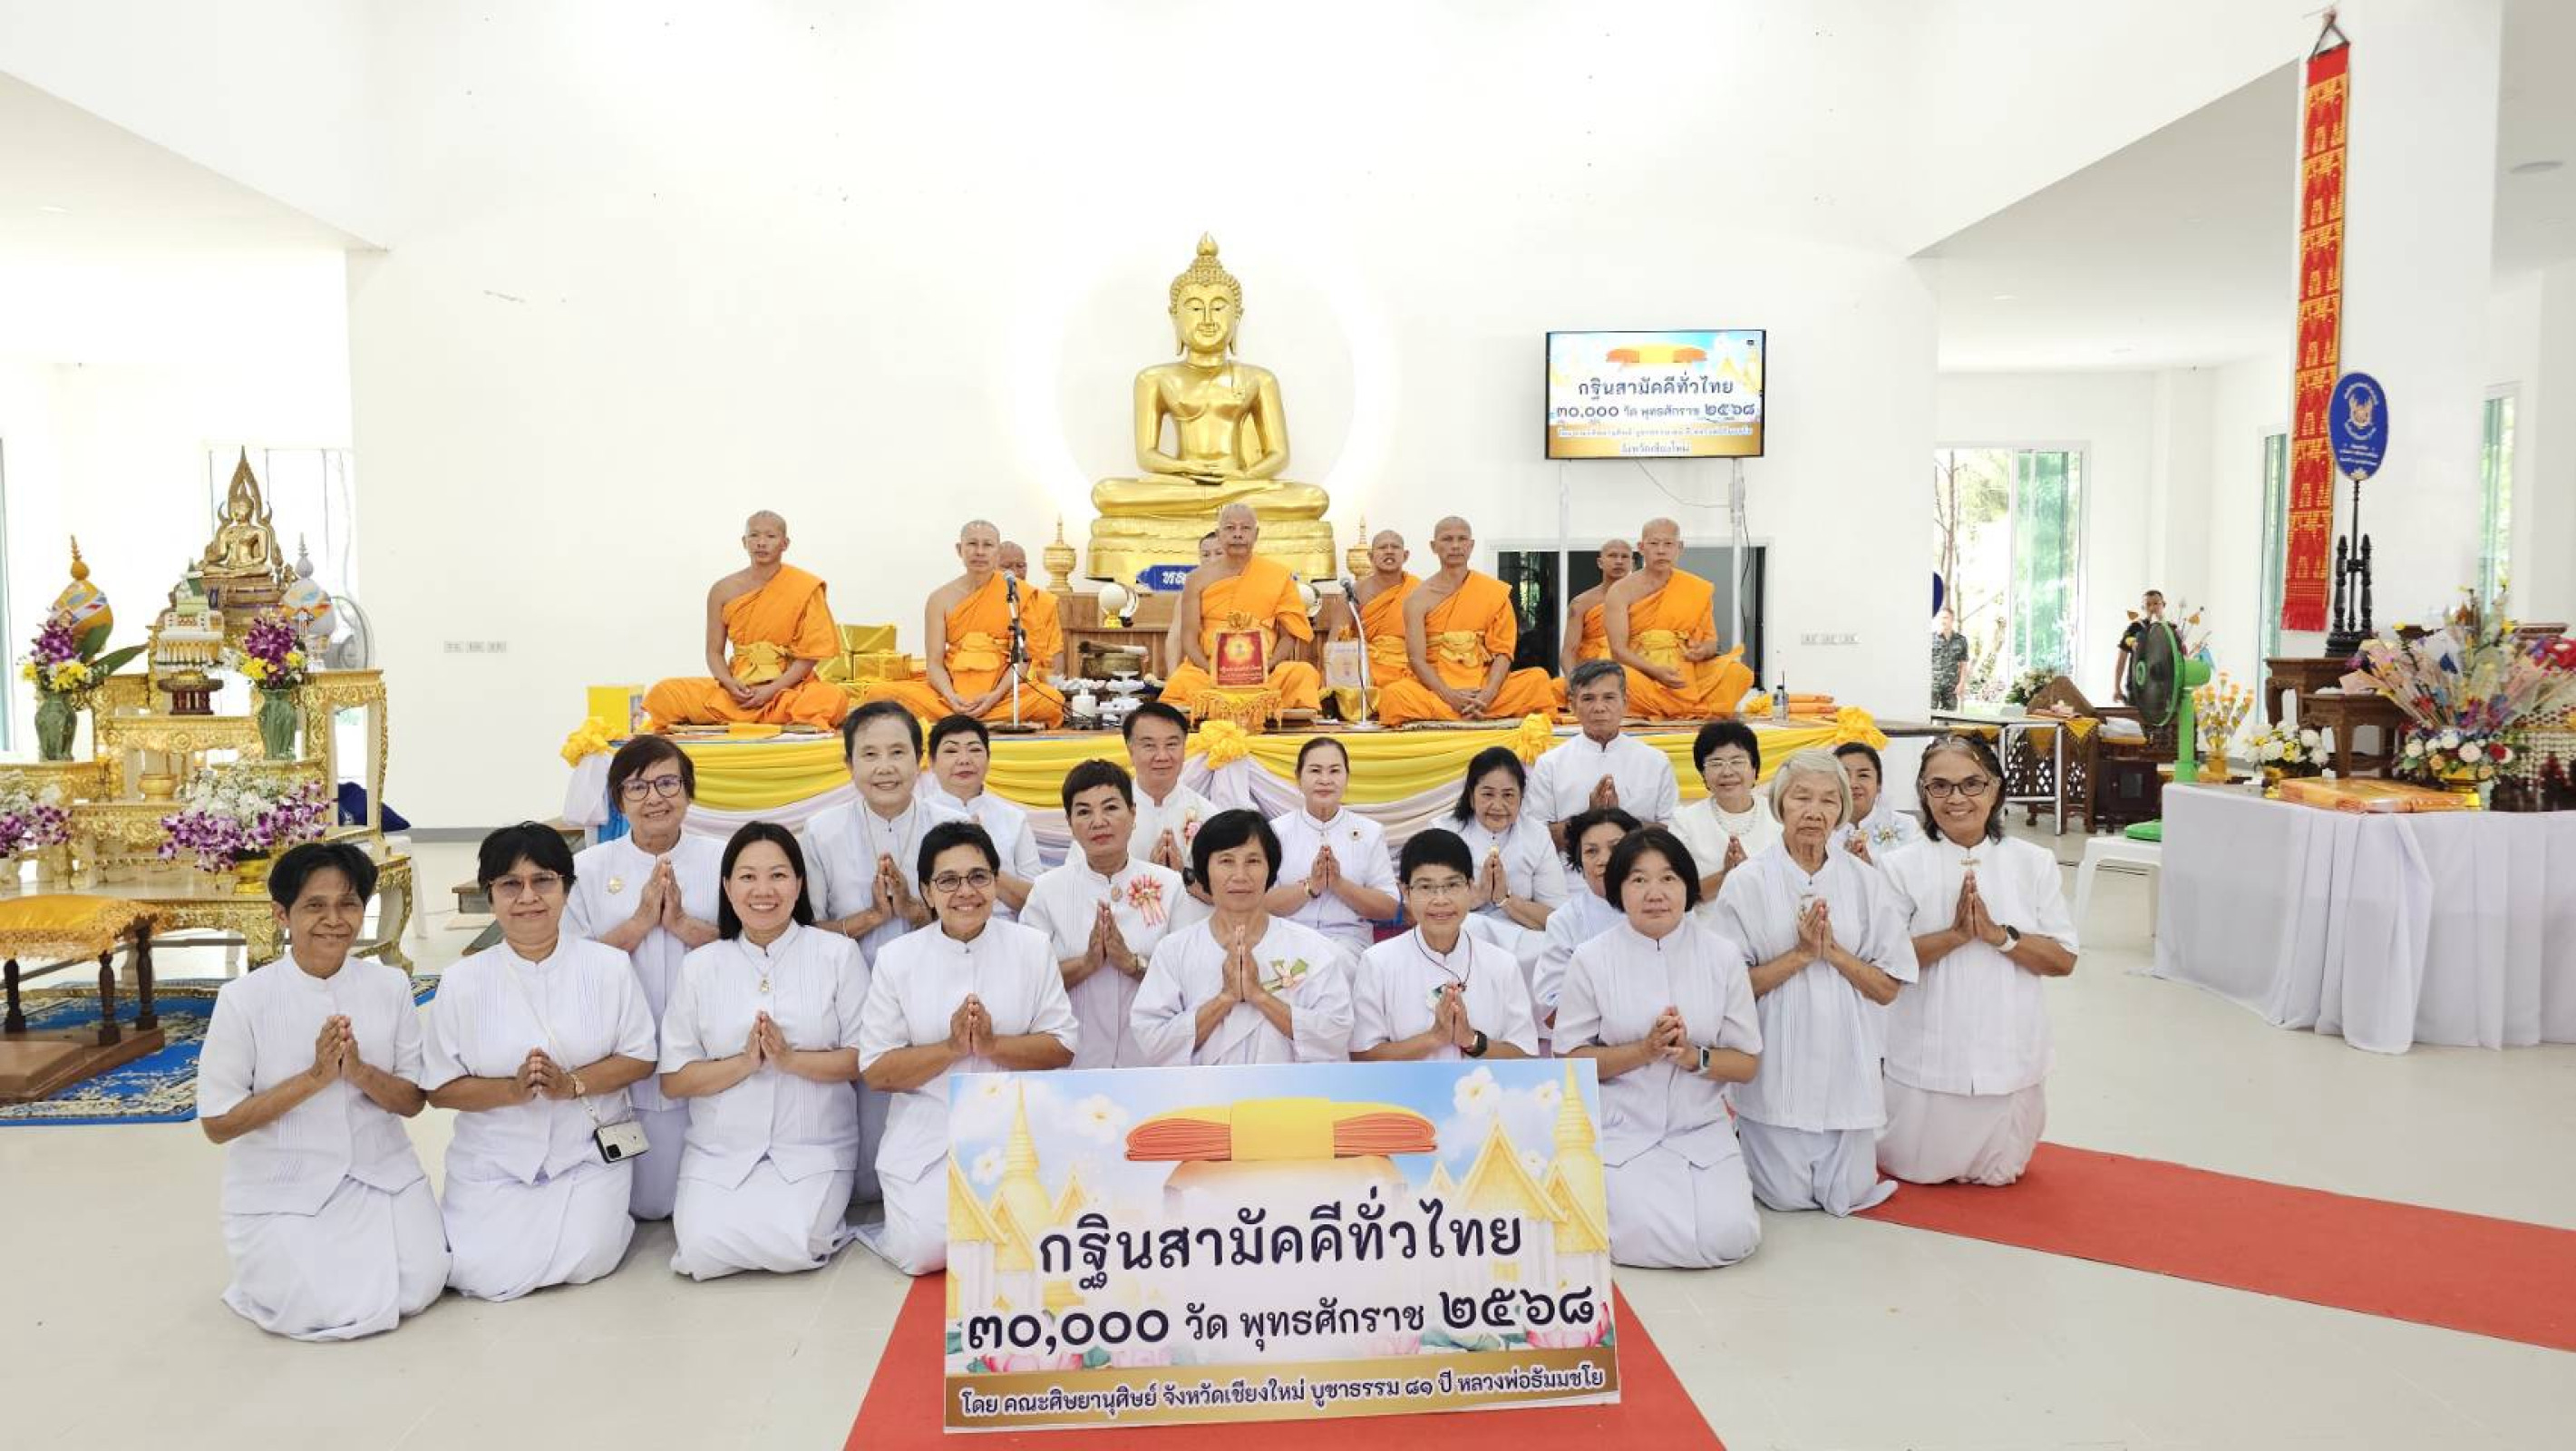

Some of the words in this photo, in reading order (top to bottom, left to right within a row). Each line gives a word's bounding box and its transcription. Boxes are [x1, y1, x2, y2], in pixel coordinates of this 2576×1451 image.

[1578, 370, 1734, 401] กฐินสามัคคีทั่วไทย
[1040, 1185, 1521, 1290] กฐินสามัคคีทั่วไทย
[968, 1310, 1169, 1355] ๓๐,๐๐๐
[1185, 1302, 1228, 1340] วัด
[1239, 1297, 1424, 1351] พุทธศักราช
[1439, 1285, 1595, 1329] ๒๕๖๘
[962, 1391, 997, 1414] โดย
[1004, 1383, 1156, 1416] คณะศิษยานุศิษย์
[1163, 1376, 1305, 1406] จังหวัดเชียงใหม่
[1312, 1378, 1400, 1407] บูชาธรรม
[1405, 1378, 1434, 1396] ๘๑
[1438, 1369, 1452, 1394] ปี
[1457, 1364, 1603, 1392] หลวงพ่อธัมมชโย
